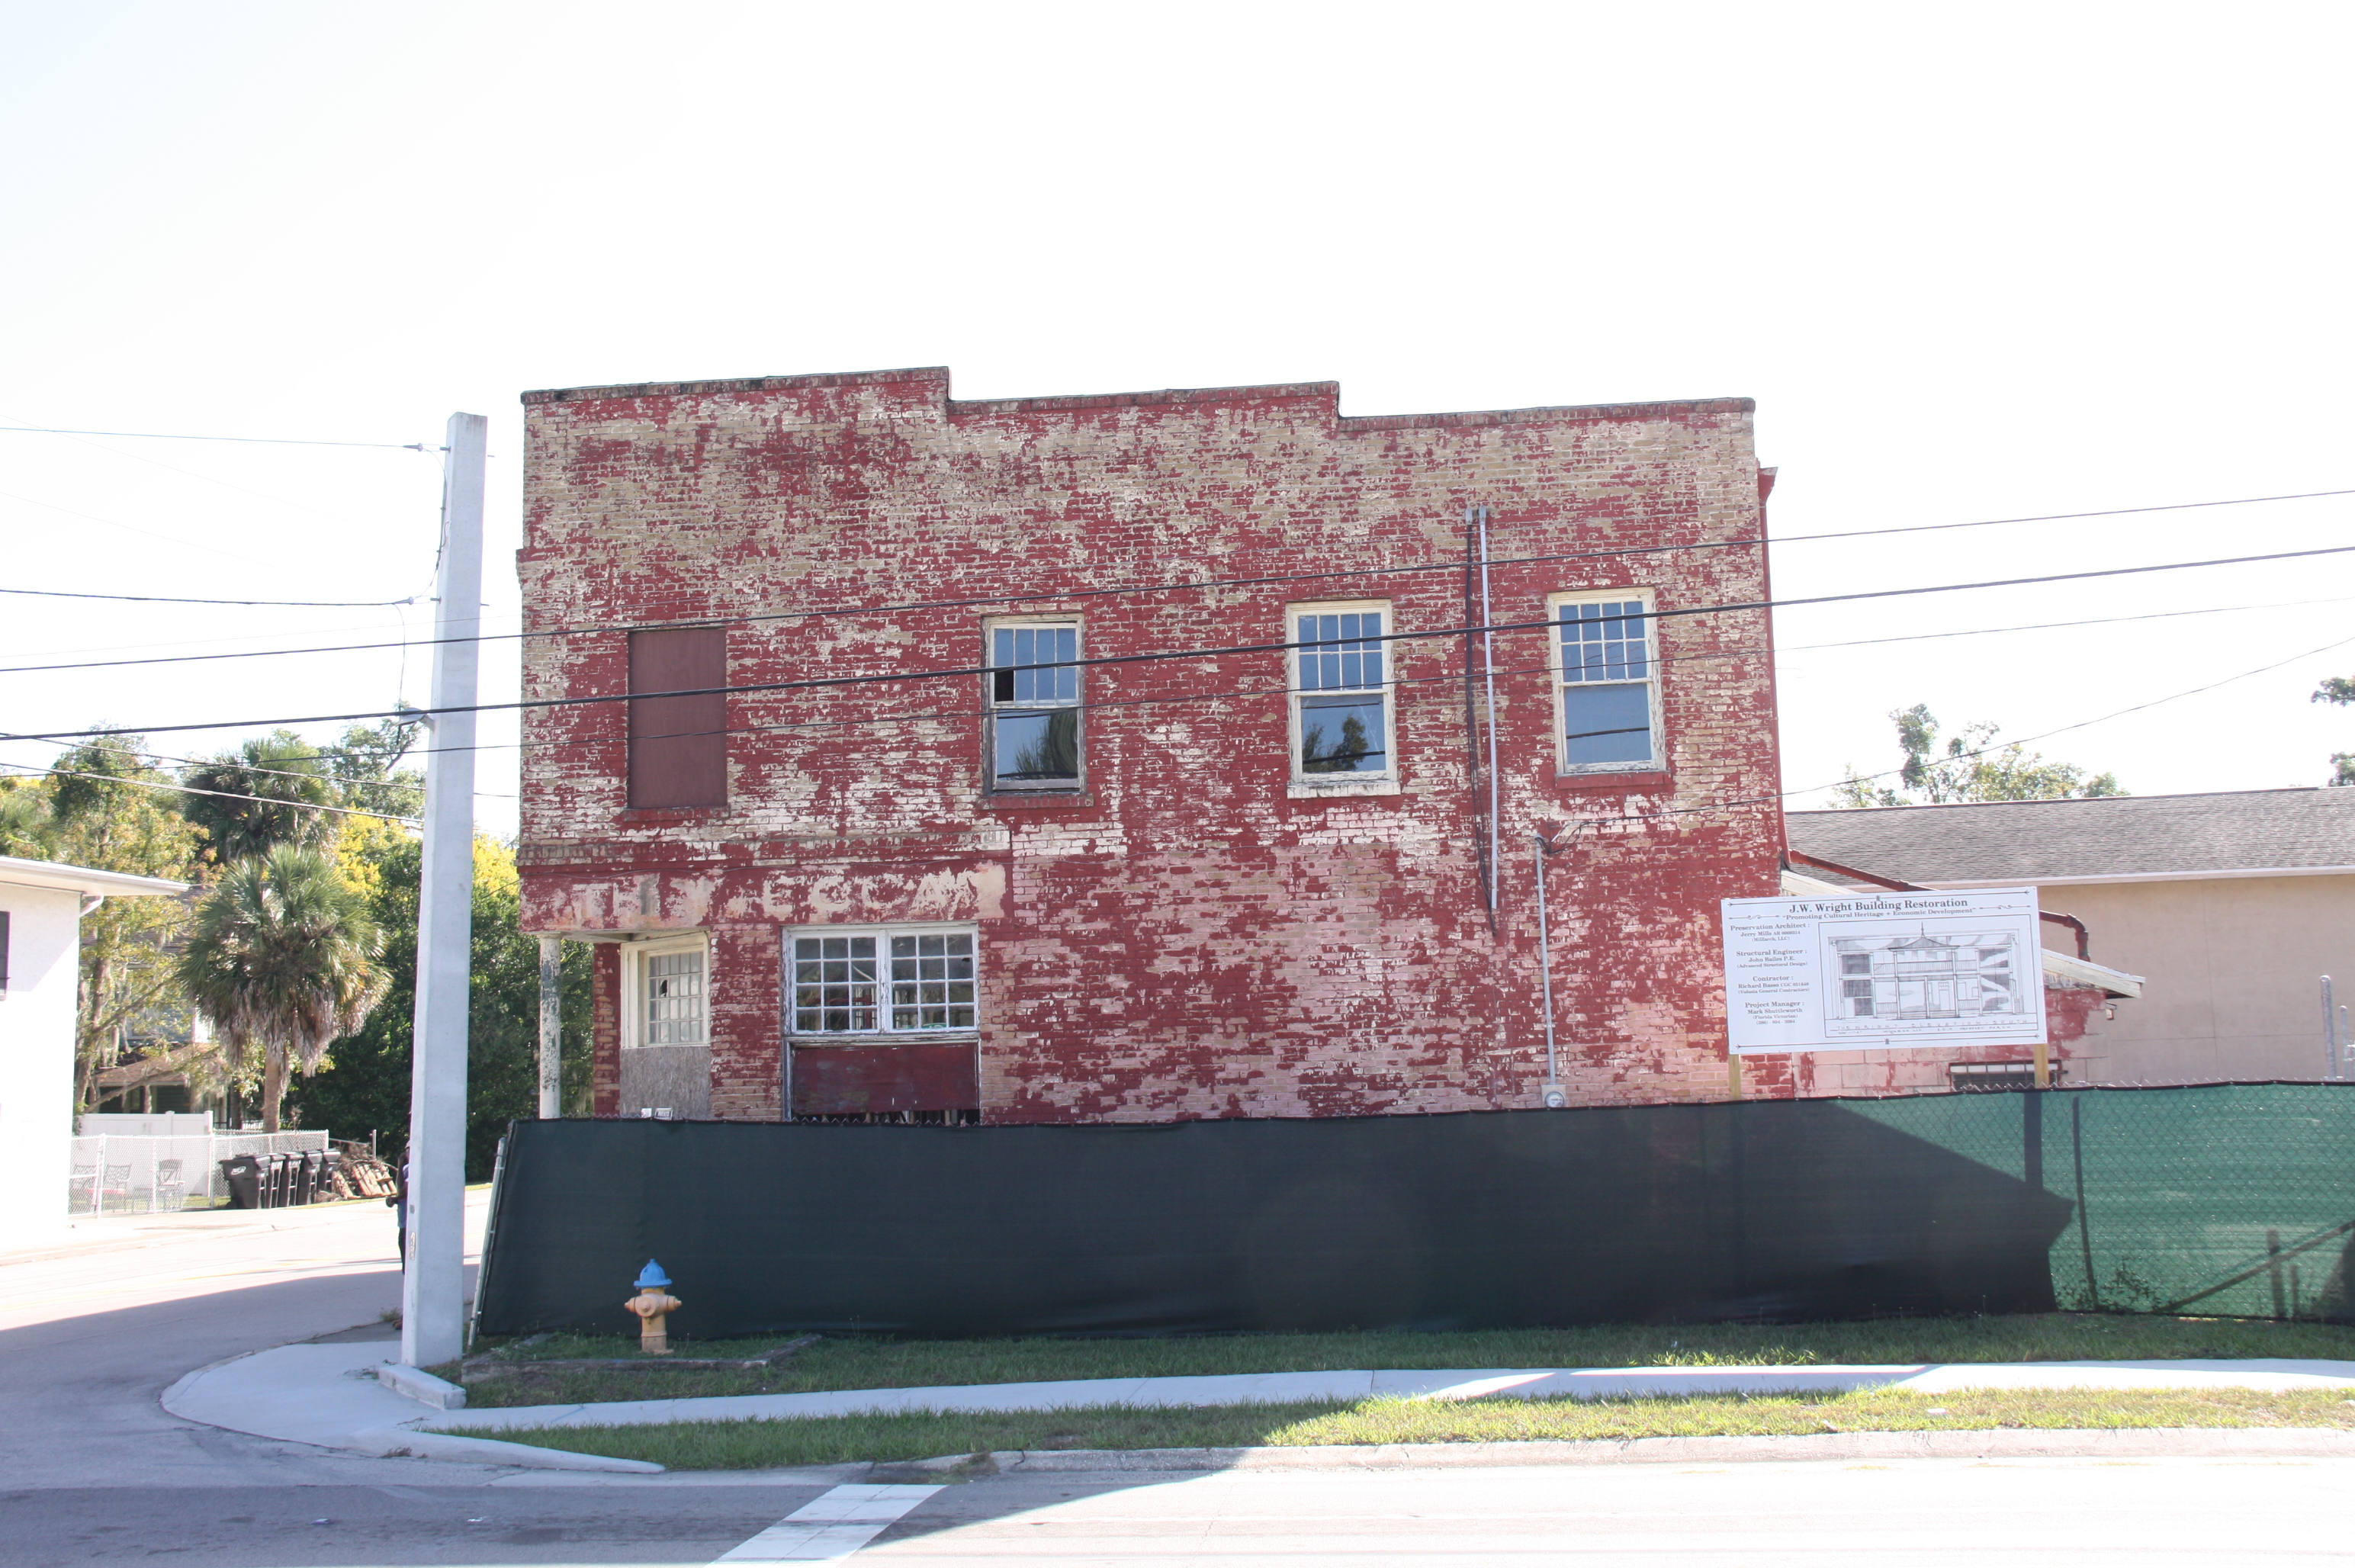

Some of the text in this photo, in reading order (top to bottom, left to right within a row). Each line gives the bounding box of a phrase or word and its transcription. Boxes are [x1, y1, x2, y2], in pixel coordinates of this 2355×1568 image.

[1789, 898, 1968, 914] J.W. Wright Building Restoration
[1854, 910, 1884, 918] Heritage
